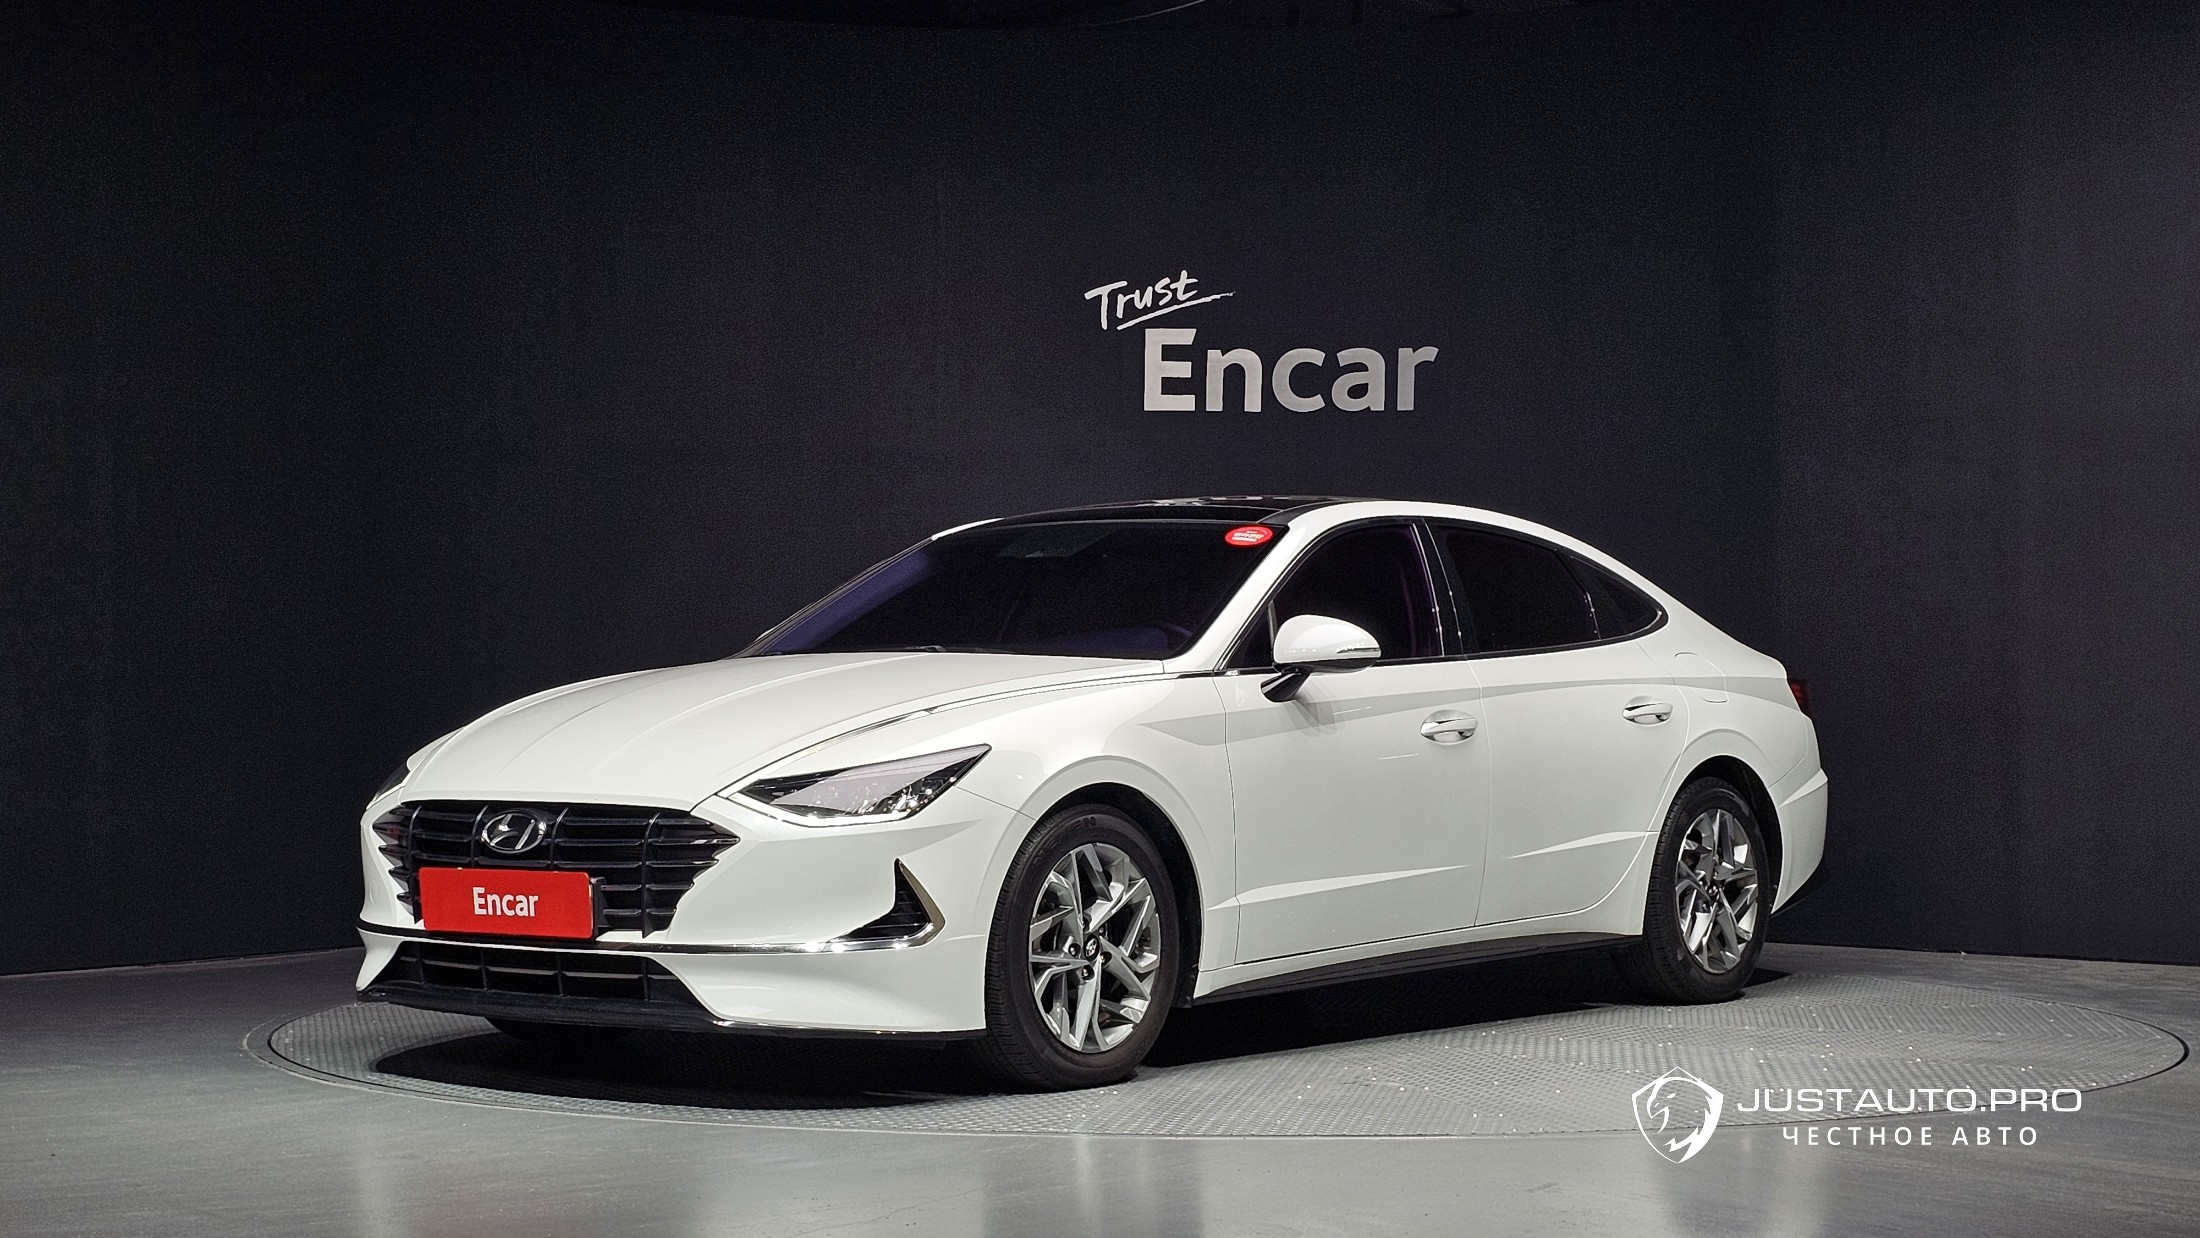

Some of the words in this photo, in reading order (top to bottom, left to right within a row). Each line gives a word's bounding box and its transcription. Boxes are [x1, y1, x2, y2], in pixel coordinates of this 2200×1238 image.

[1084, 270, 1198, 330] Trust
[1144, 328, 1439, 412] Encar
[472, 886, 539, 917] Encar
